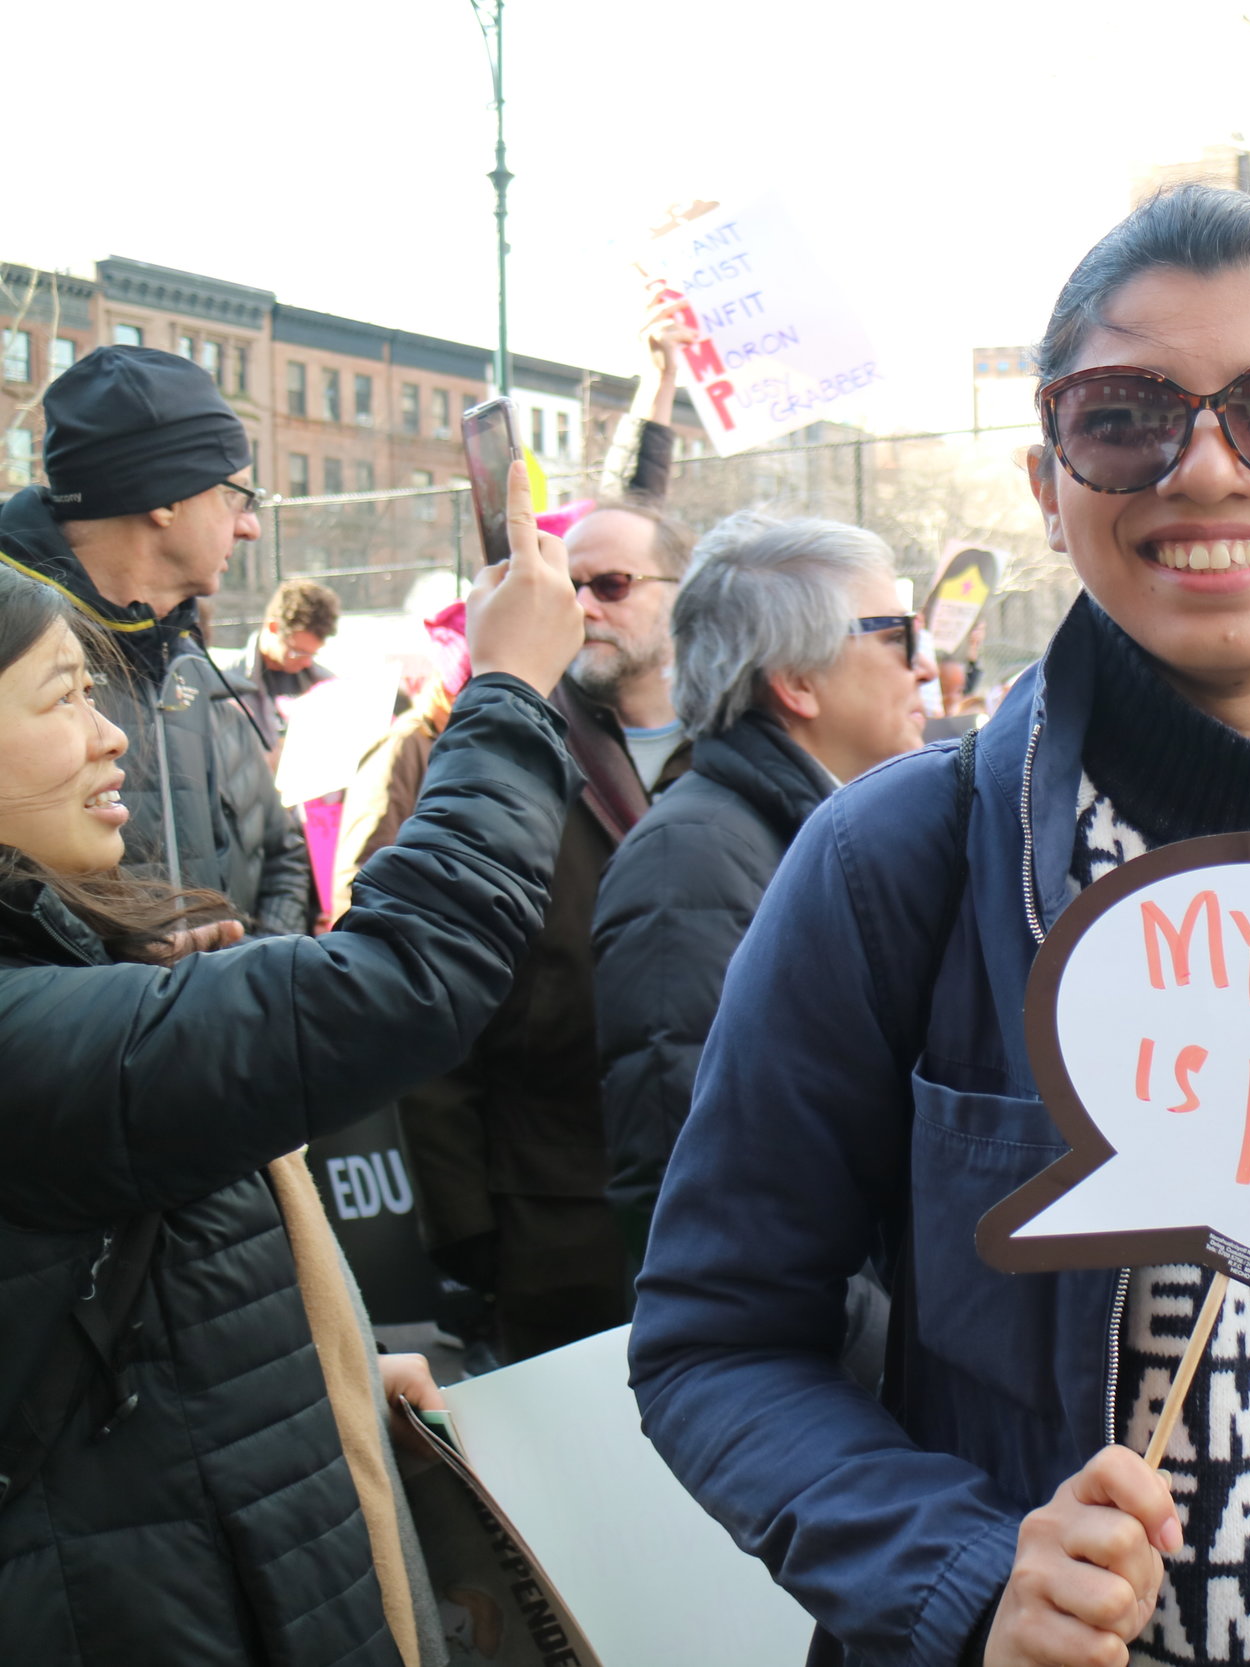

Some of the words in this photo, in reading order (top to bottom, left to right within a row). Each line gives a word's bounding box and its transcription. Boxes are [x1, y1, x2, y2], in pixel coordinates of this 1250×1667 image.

[679, 325, 801, 385] MORON
[768, 360, 886, 423] GRABBER
[1135, 1037, 1209, 1114] IS
[326, 1148, 414, 1221] EDU
